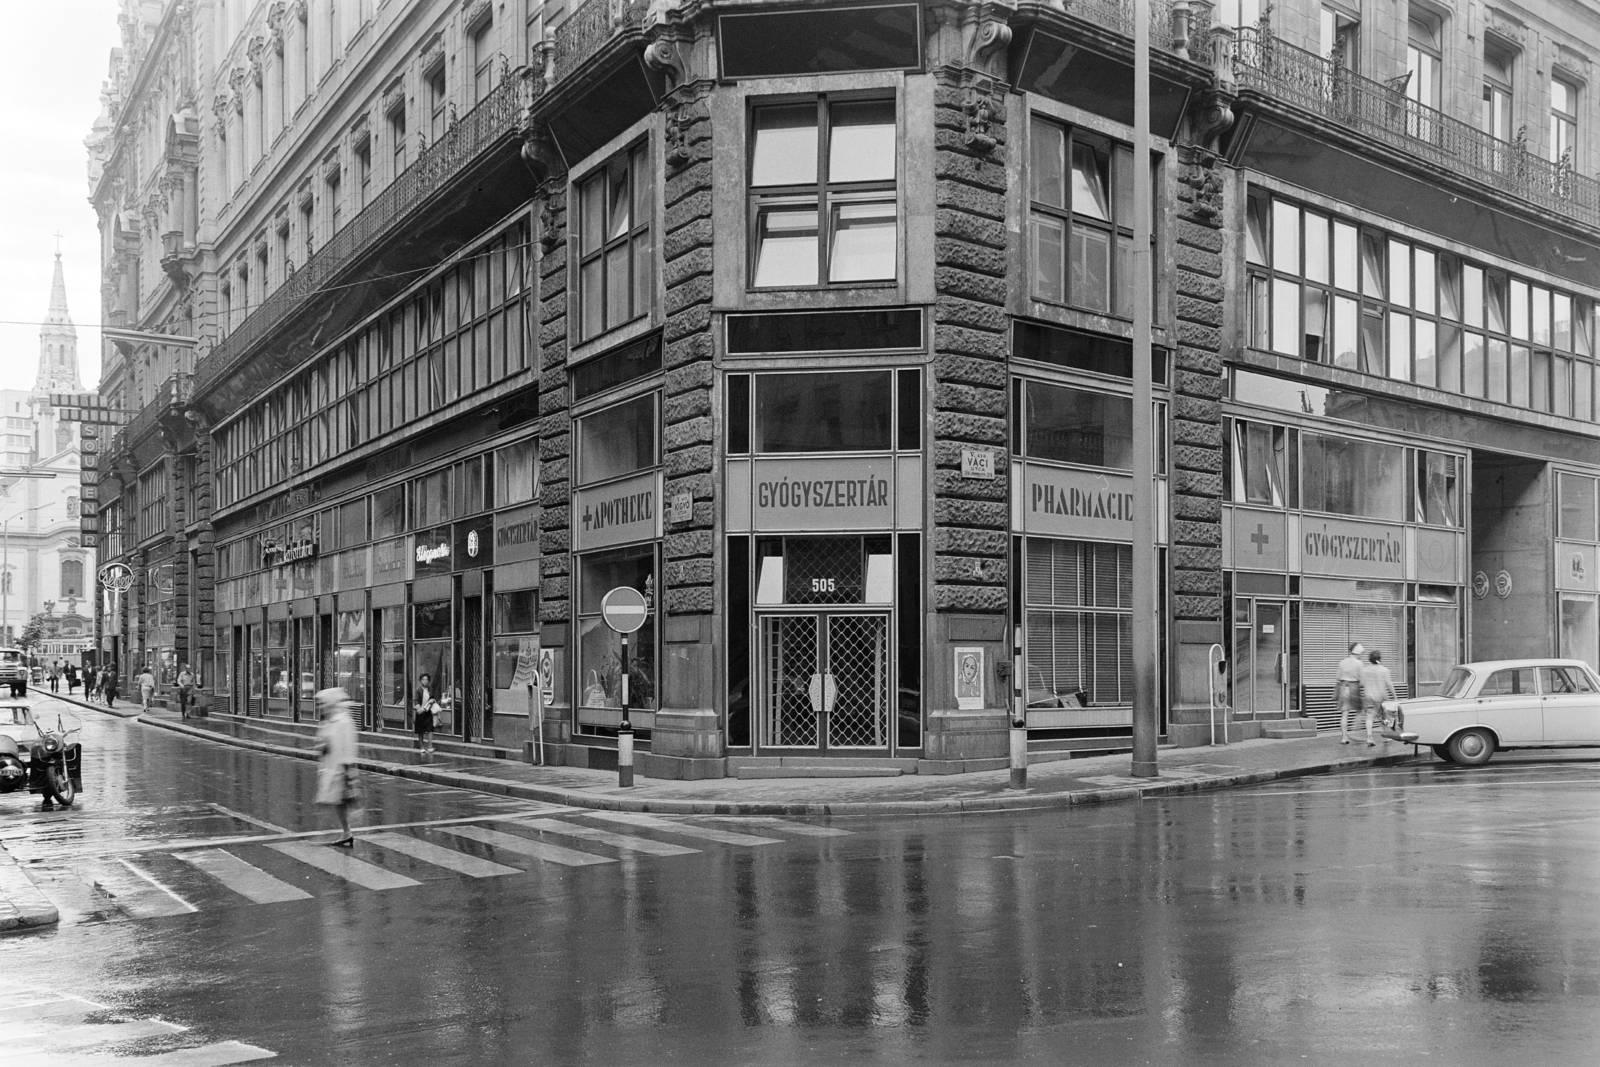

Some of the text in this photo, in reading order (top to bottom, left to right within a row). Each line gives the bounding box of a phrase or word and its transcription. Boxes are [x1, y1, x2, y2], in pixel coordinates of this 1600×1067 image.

[967, 457, 988, 468] VÁCI
[84, 425, 96, 546] SOUVENIR
[758, 474, 888, 508] GYÓGYSZERTÁR
[593, 491, 652, 530] APOTHEKE
[1305, 524, 1401, 564] GYÓGYSZERTÁR
[812, 578, 835, 593] 505
